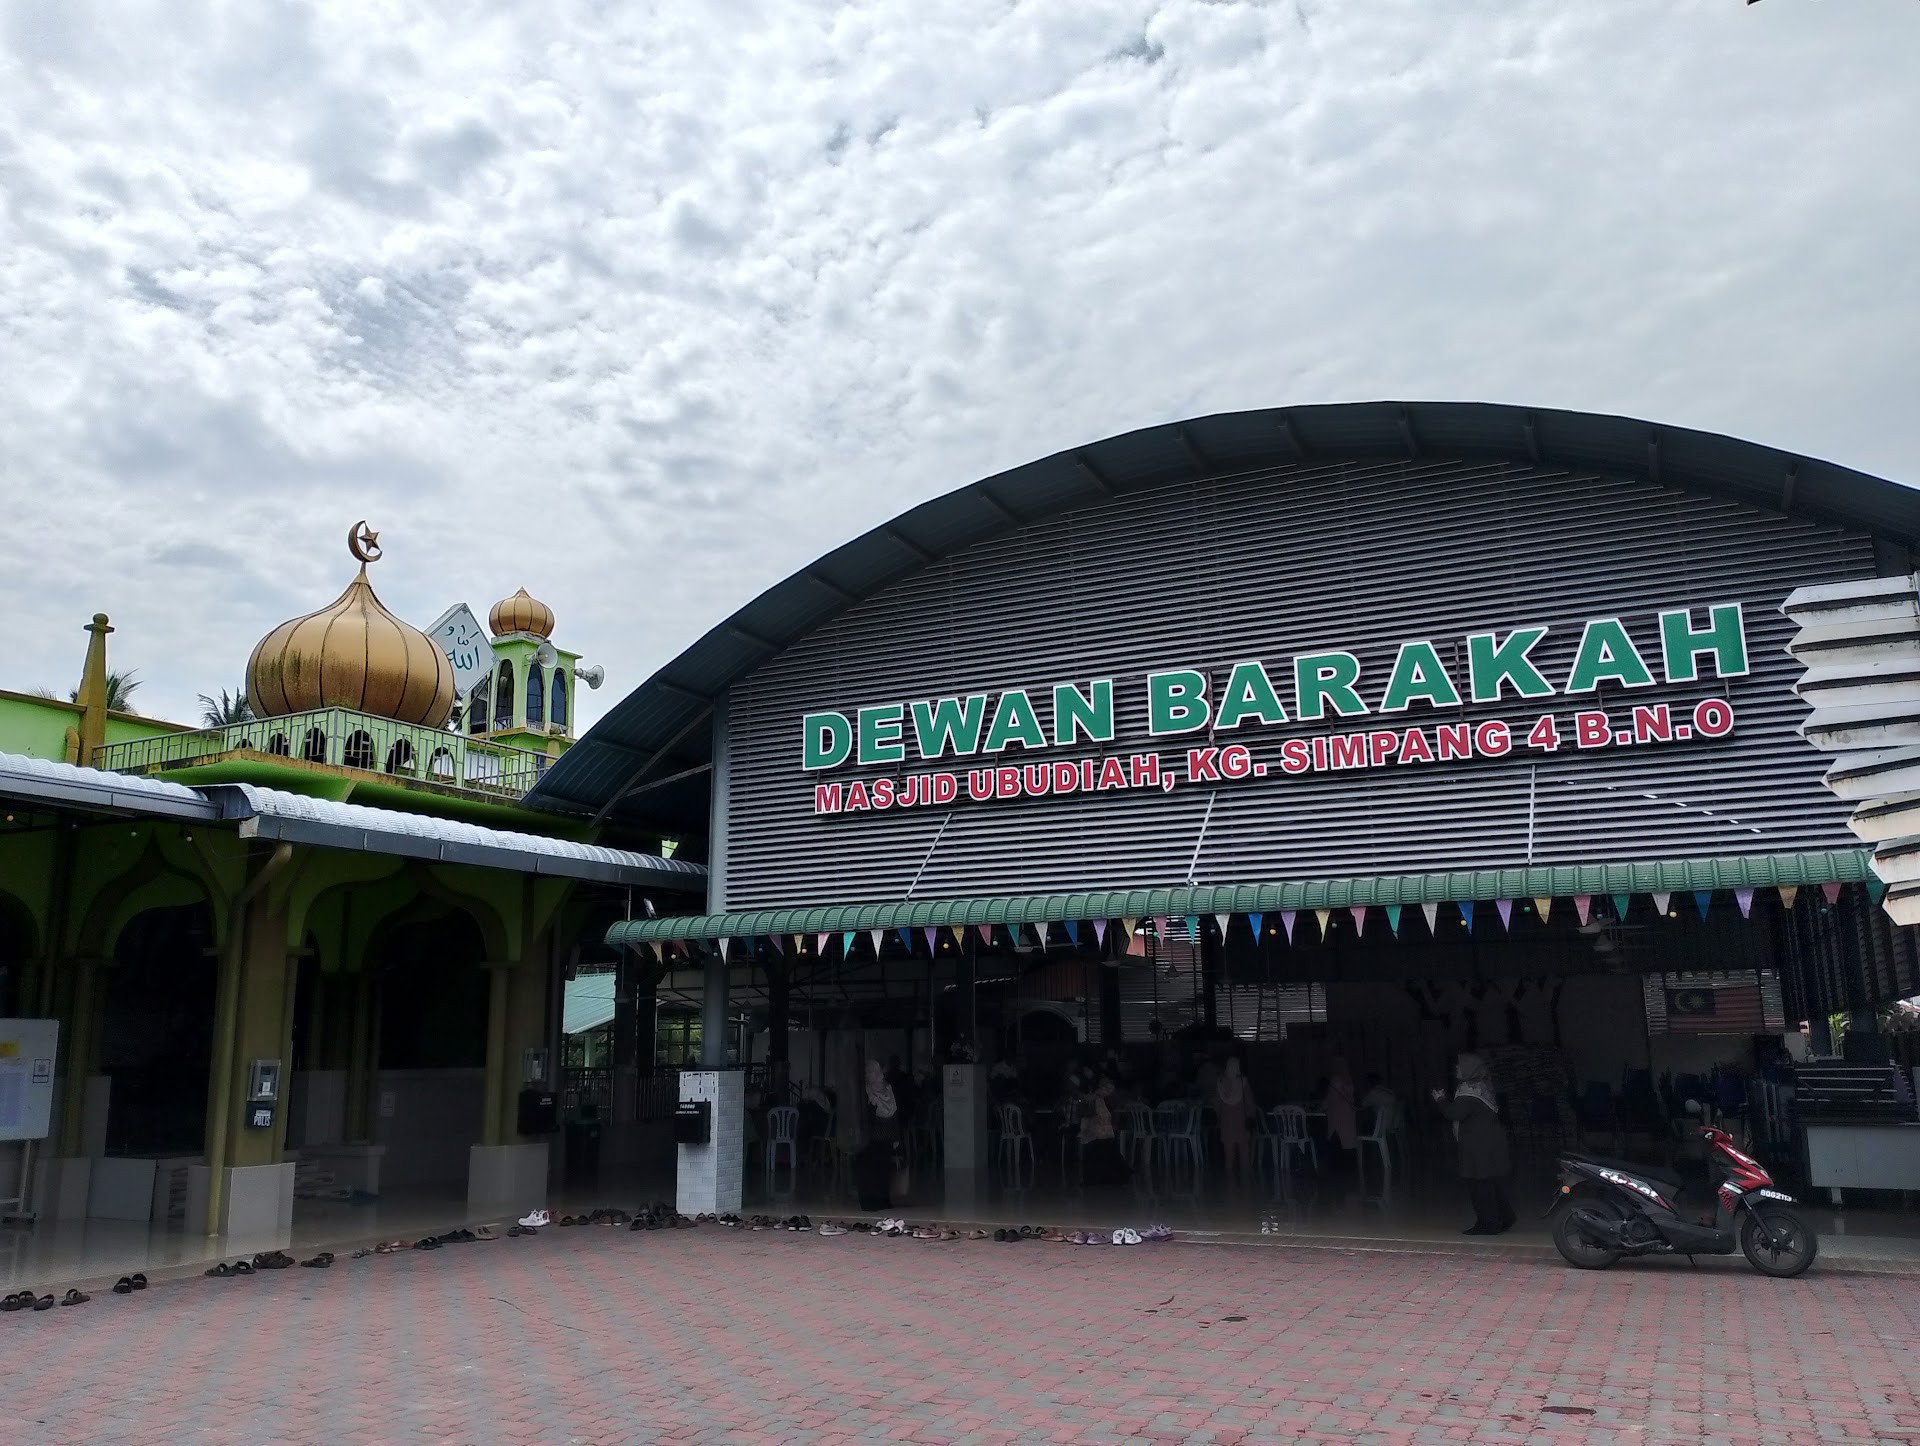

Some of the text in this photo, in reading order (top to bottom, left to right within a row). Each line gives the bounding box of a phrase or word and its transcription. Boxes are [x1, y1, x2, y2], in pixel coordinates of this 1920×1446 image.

[802, 602, 1750, 771] DEWAN BARAKAH
[814, 699, 1735, 814] MASJID UBUDIAH, KG. SIMPANG 4 B.N.O
[253, 1115, 271, 1127] POLIS
